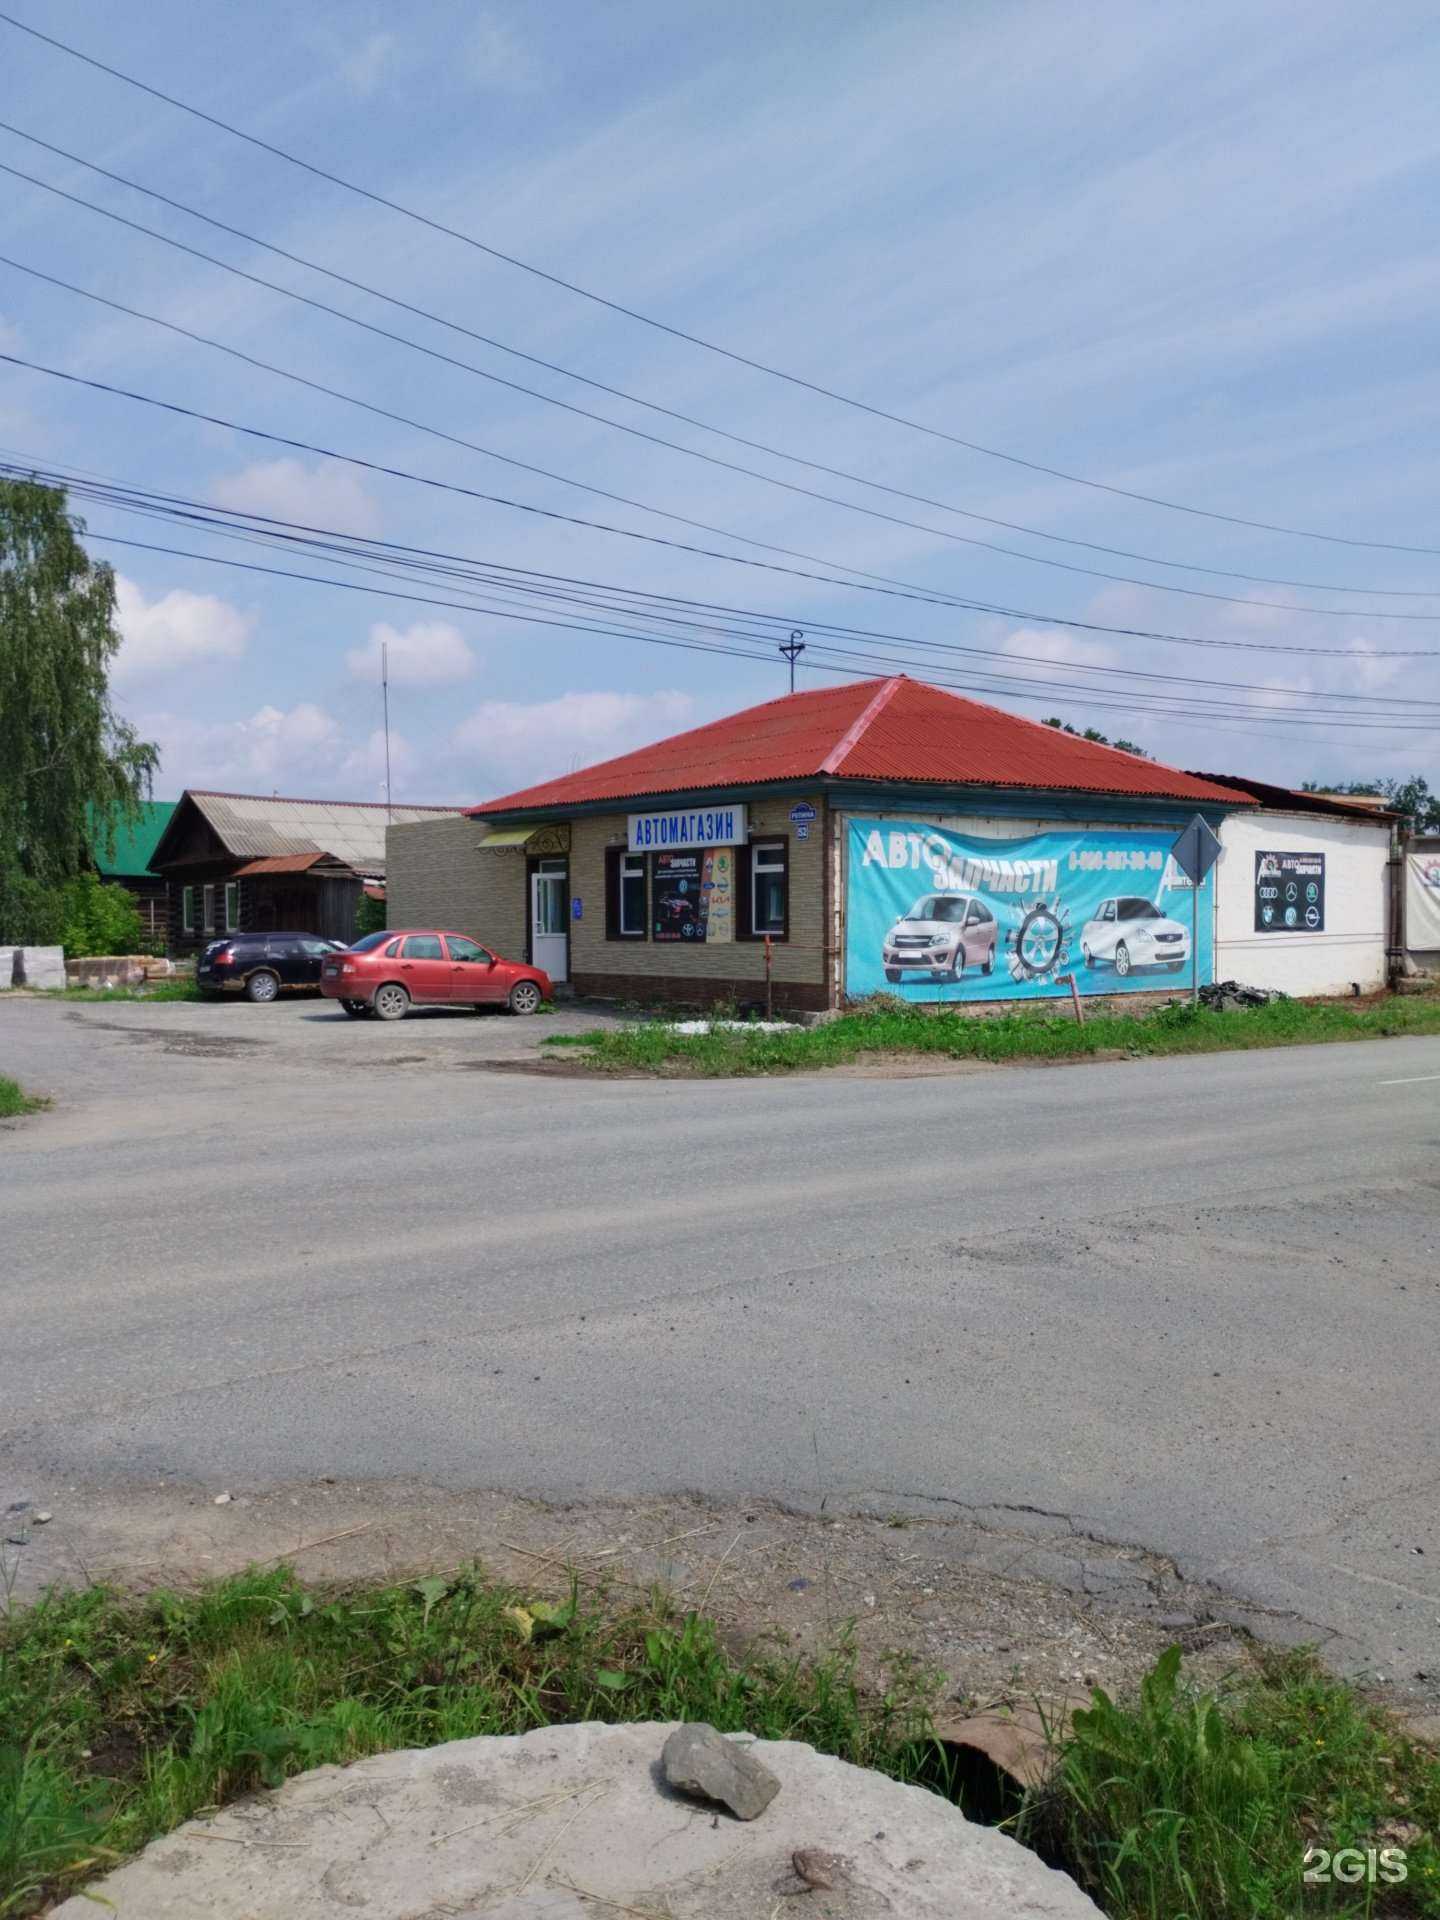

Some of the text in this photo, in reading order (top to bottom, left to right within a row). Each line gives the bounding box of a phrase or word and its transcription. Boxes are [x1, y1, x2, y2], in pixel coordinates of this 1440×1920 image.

[636, 811, 734, 845] АВТОМАГАЗИН
[862, 830, 953, 871] АВТО
[933, 858, 1059, 893] ЗАПЧАСТИ
